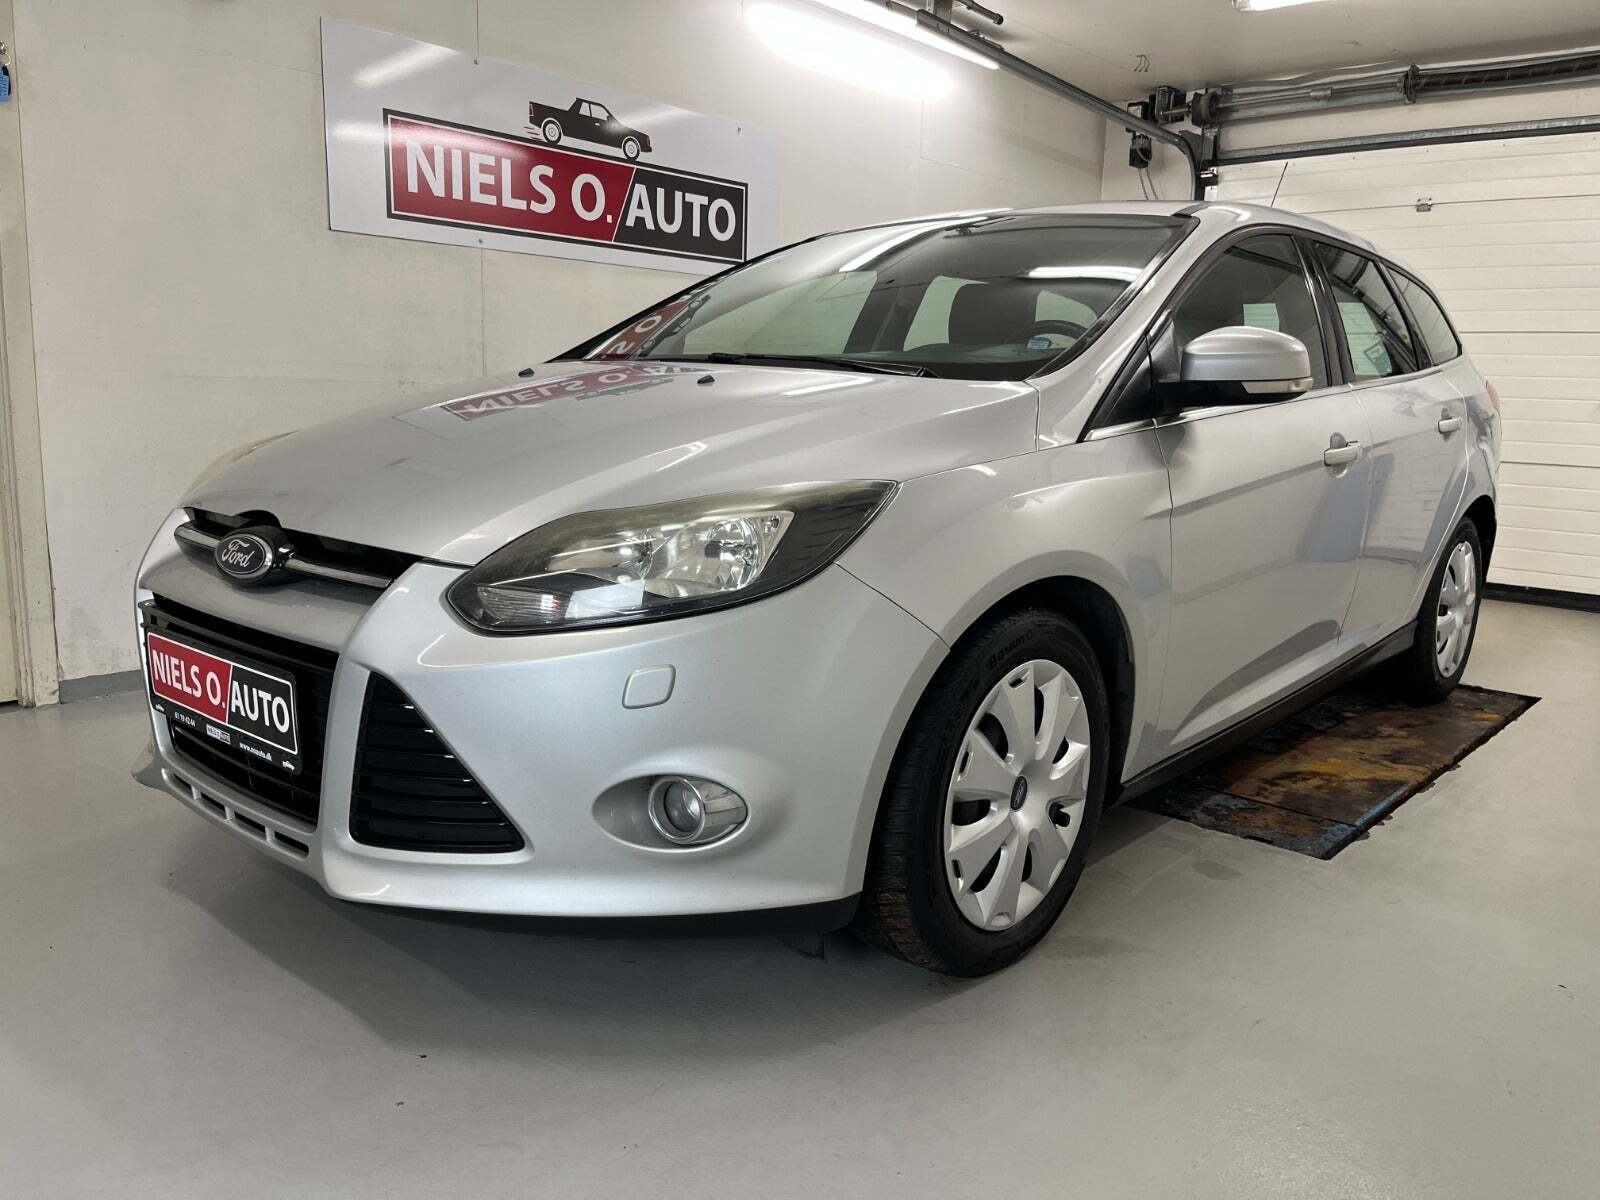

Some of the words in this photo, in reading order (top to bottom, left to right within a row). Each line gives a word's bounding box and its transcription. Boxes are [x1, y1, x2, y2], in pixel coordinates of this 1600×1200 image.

[406, 139, 556, 216] NIELS
[570, 173, 614, 224] O.
[625, 183, 737, 242] AUTO
[222, 539, 255, 568] Ford
[152, 650, 202, 698] NIELS
[205, 671, 226, 709] O.
[231, 680, 290, 733] AUTO
